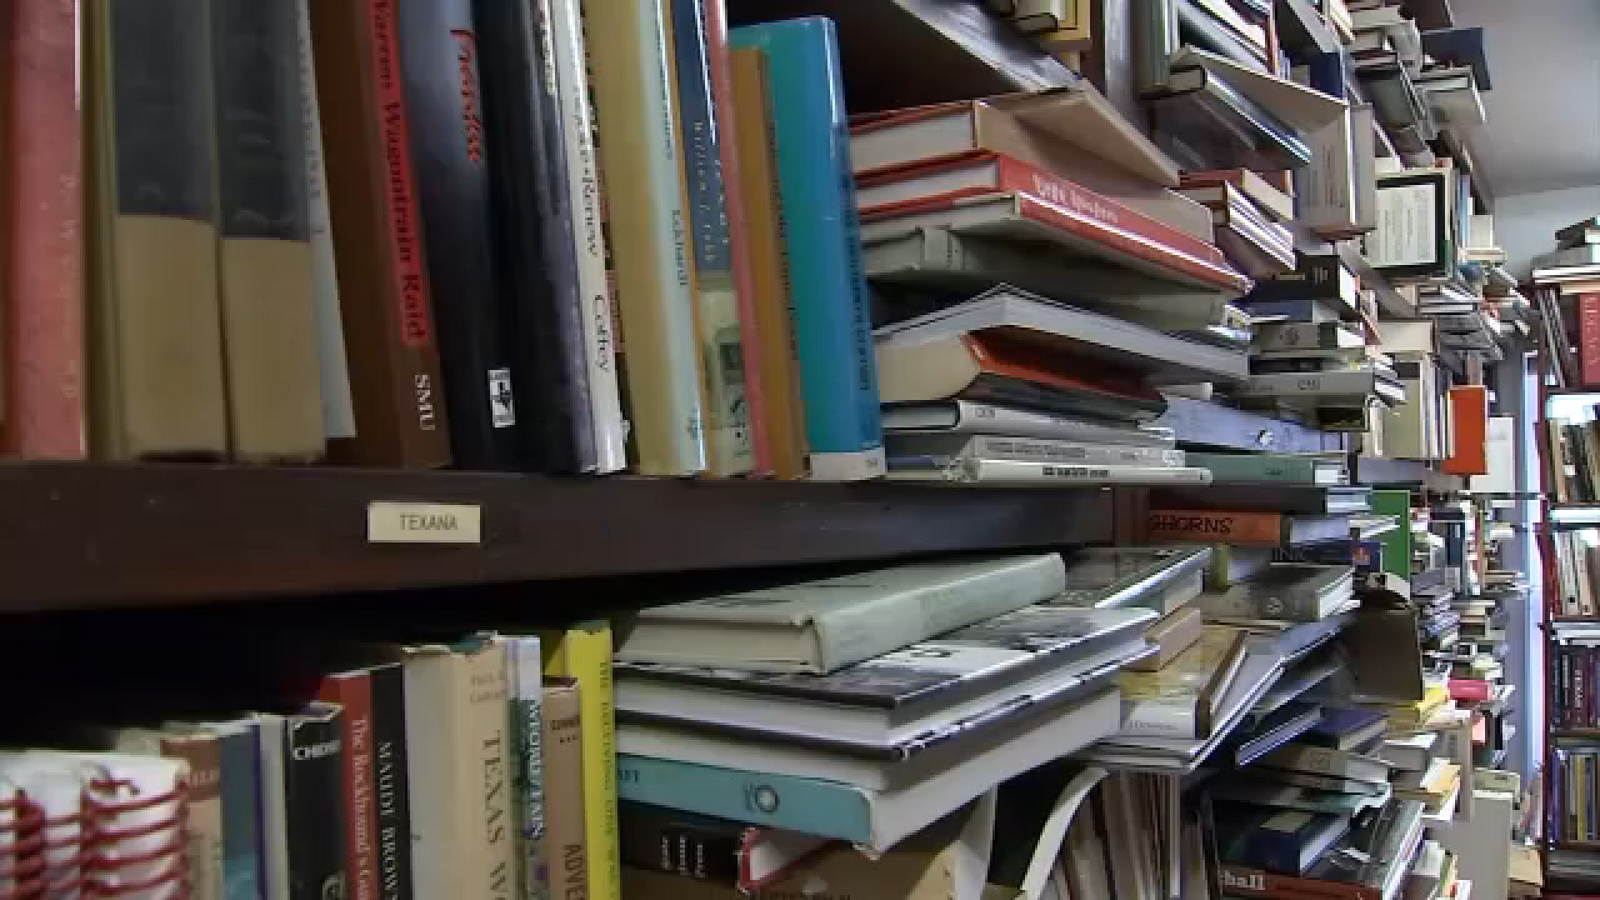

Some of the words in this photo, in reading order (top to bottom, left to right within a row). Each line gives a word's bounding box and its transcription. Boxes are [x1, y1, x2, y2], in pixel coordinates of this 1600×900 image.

[385, 101, 412, 263] Wagontrain
[402, 274, 426, 340] Raid
[414, 373, 436, 431] SMU
[399, 513, 459, 531] TEXANA
[352, 716, 369, 749] The
[379, 741, 395, 816] MAUDE
[484, 730, 503, 844] TEXAS
